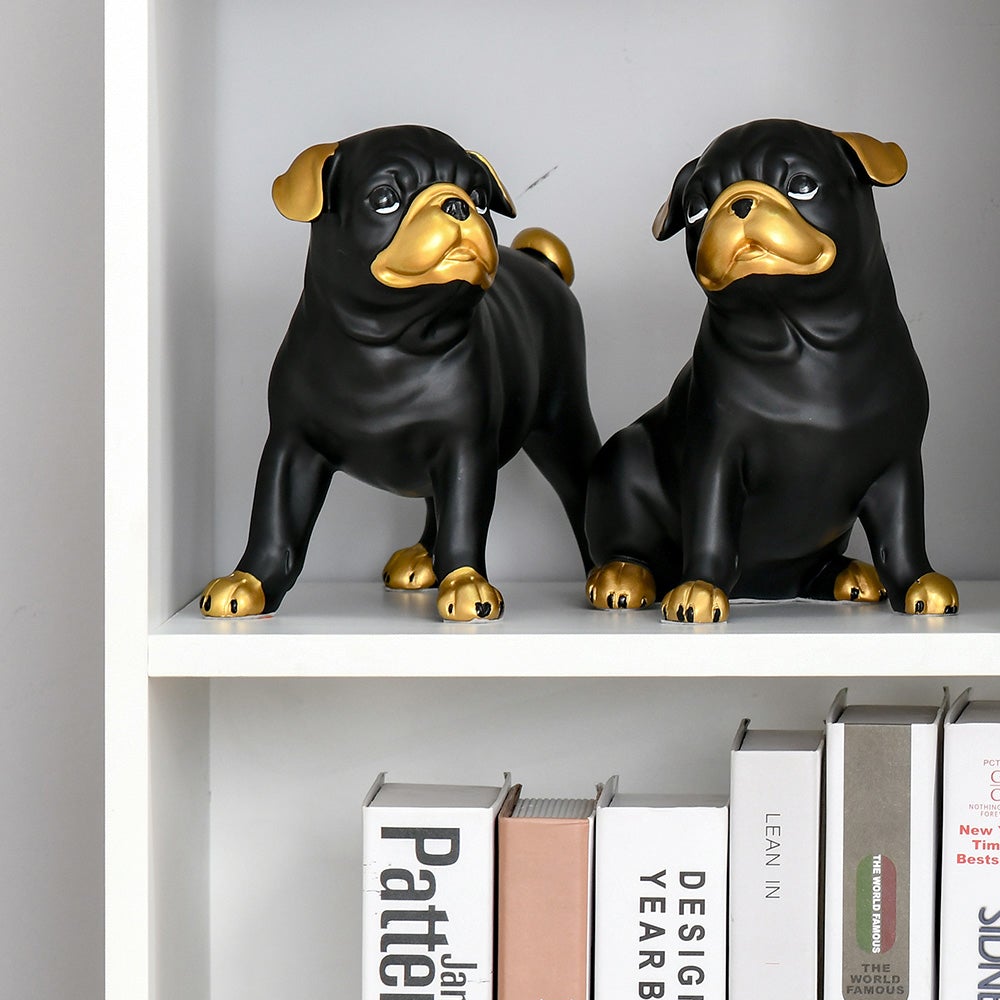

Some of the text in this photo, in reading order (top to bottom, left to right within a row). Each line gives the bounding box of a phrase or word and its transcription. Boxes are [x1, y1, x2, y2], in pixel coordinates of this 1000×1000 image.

[959, 825, 993, 836] New
[765, 814, 781, 899] LEAN IN
[872, 854, 881, 954] THE WORLD FAMOUS
[861, 964, 891, 973] THE
[850, 975, 900, 984] WORLD
[846, 985, 904, 995] FAMOUS
